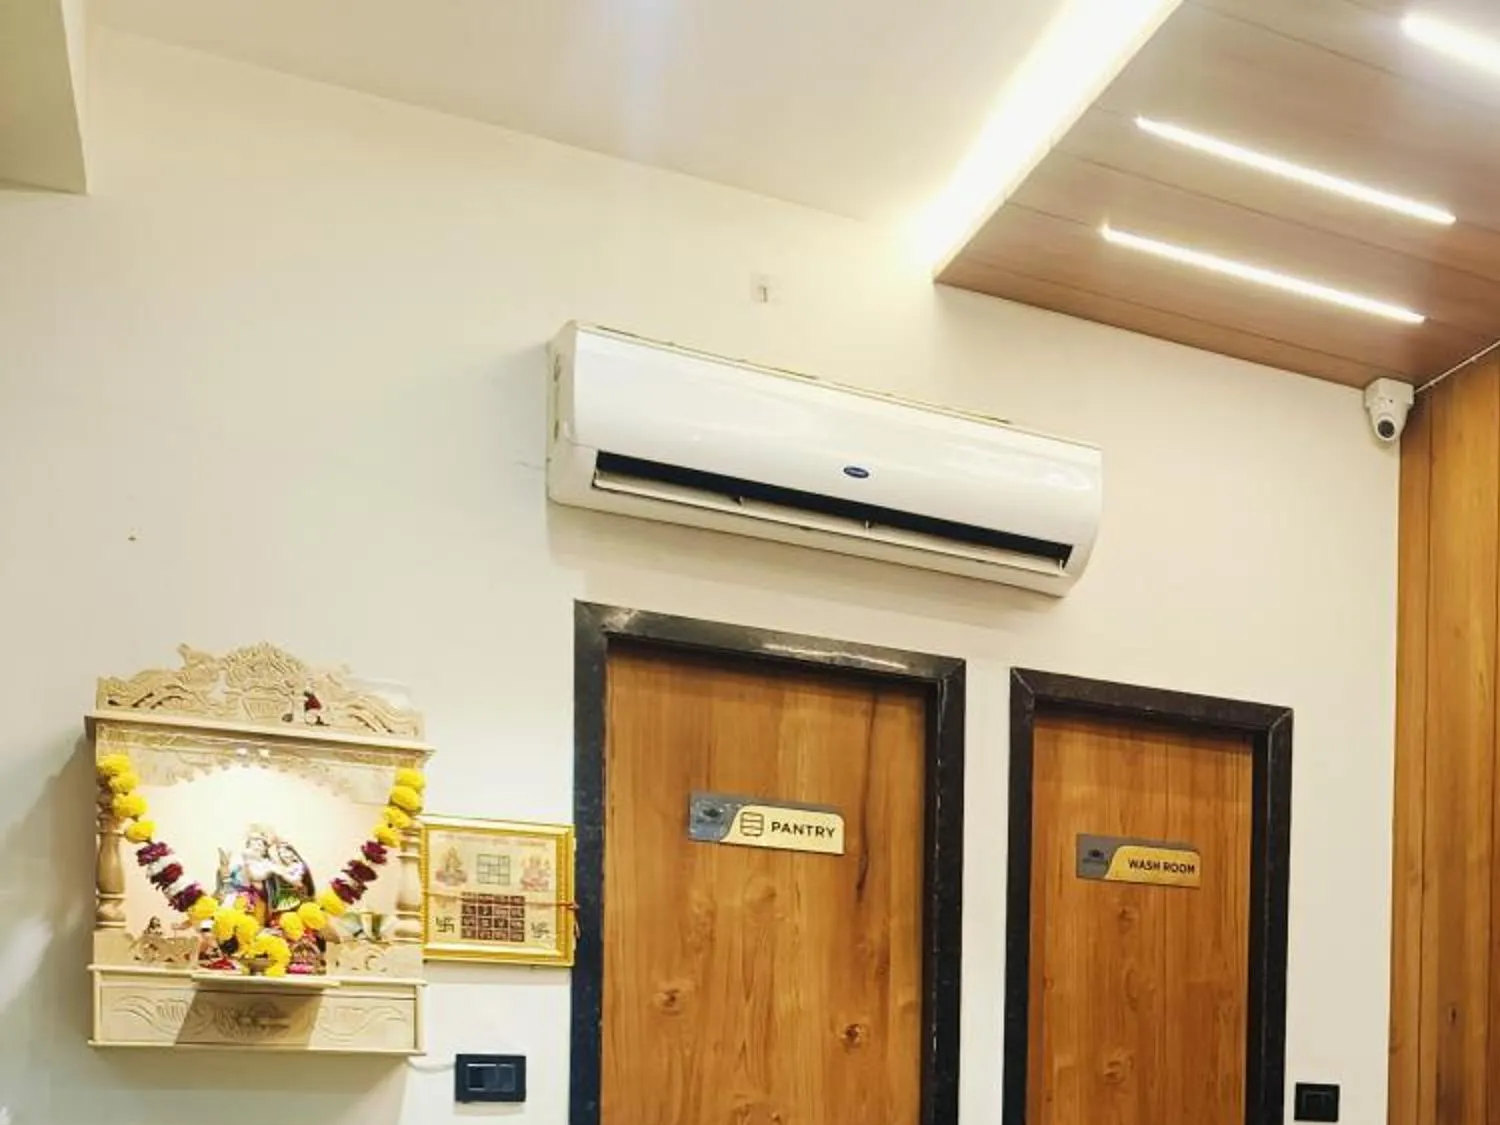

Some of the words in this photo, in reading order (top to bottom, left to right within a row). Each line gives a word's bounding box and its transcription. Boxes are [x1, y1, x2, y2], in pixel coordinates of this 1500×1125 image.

[771, 820, 836, 839] PANTRY
[1127, 859, 1161, 871] WASH
[1163, 861, 1195, 874] ROOM
